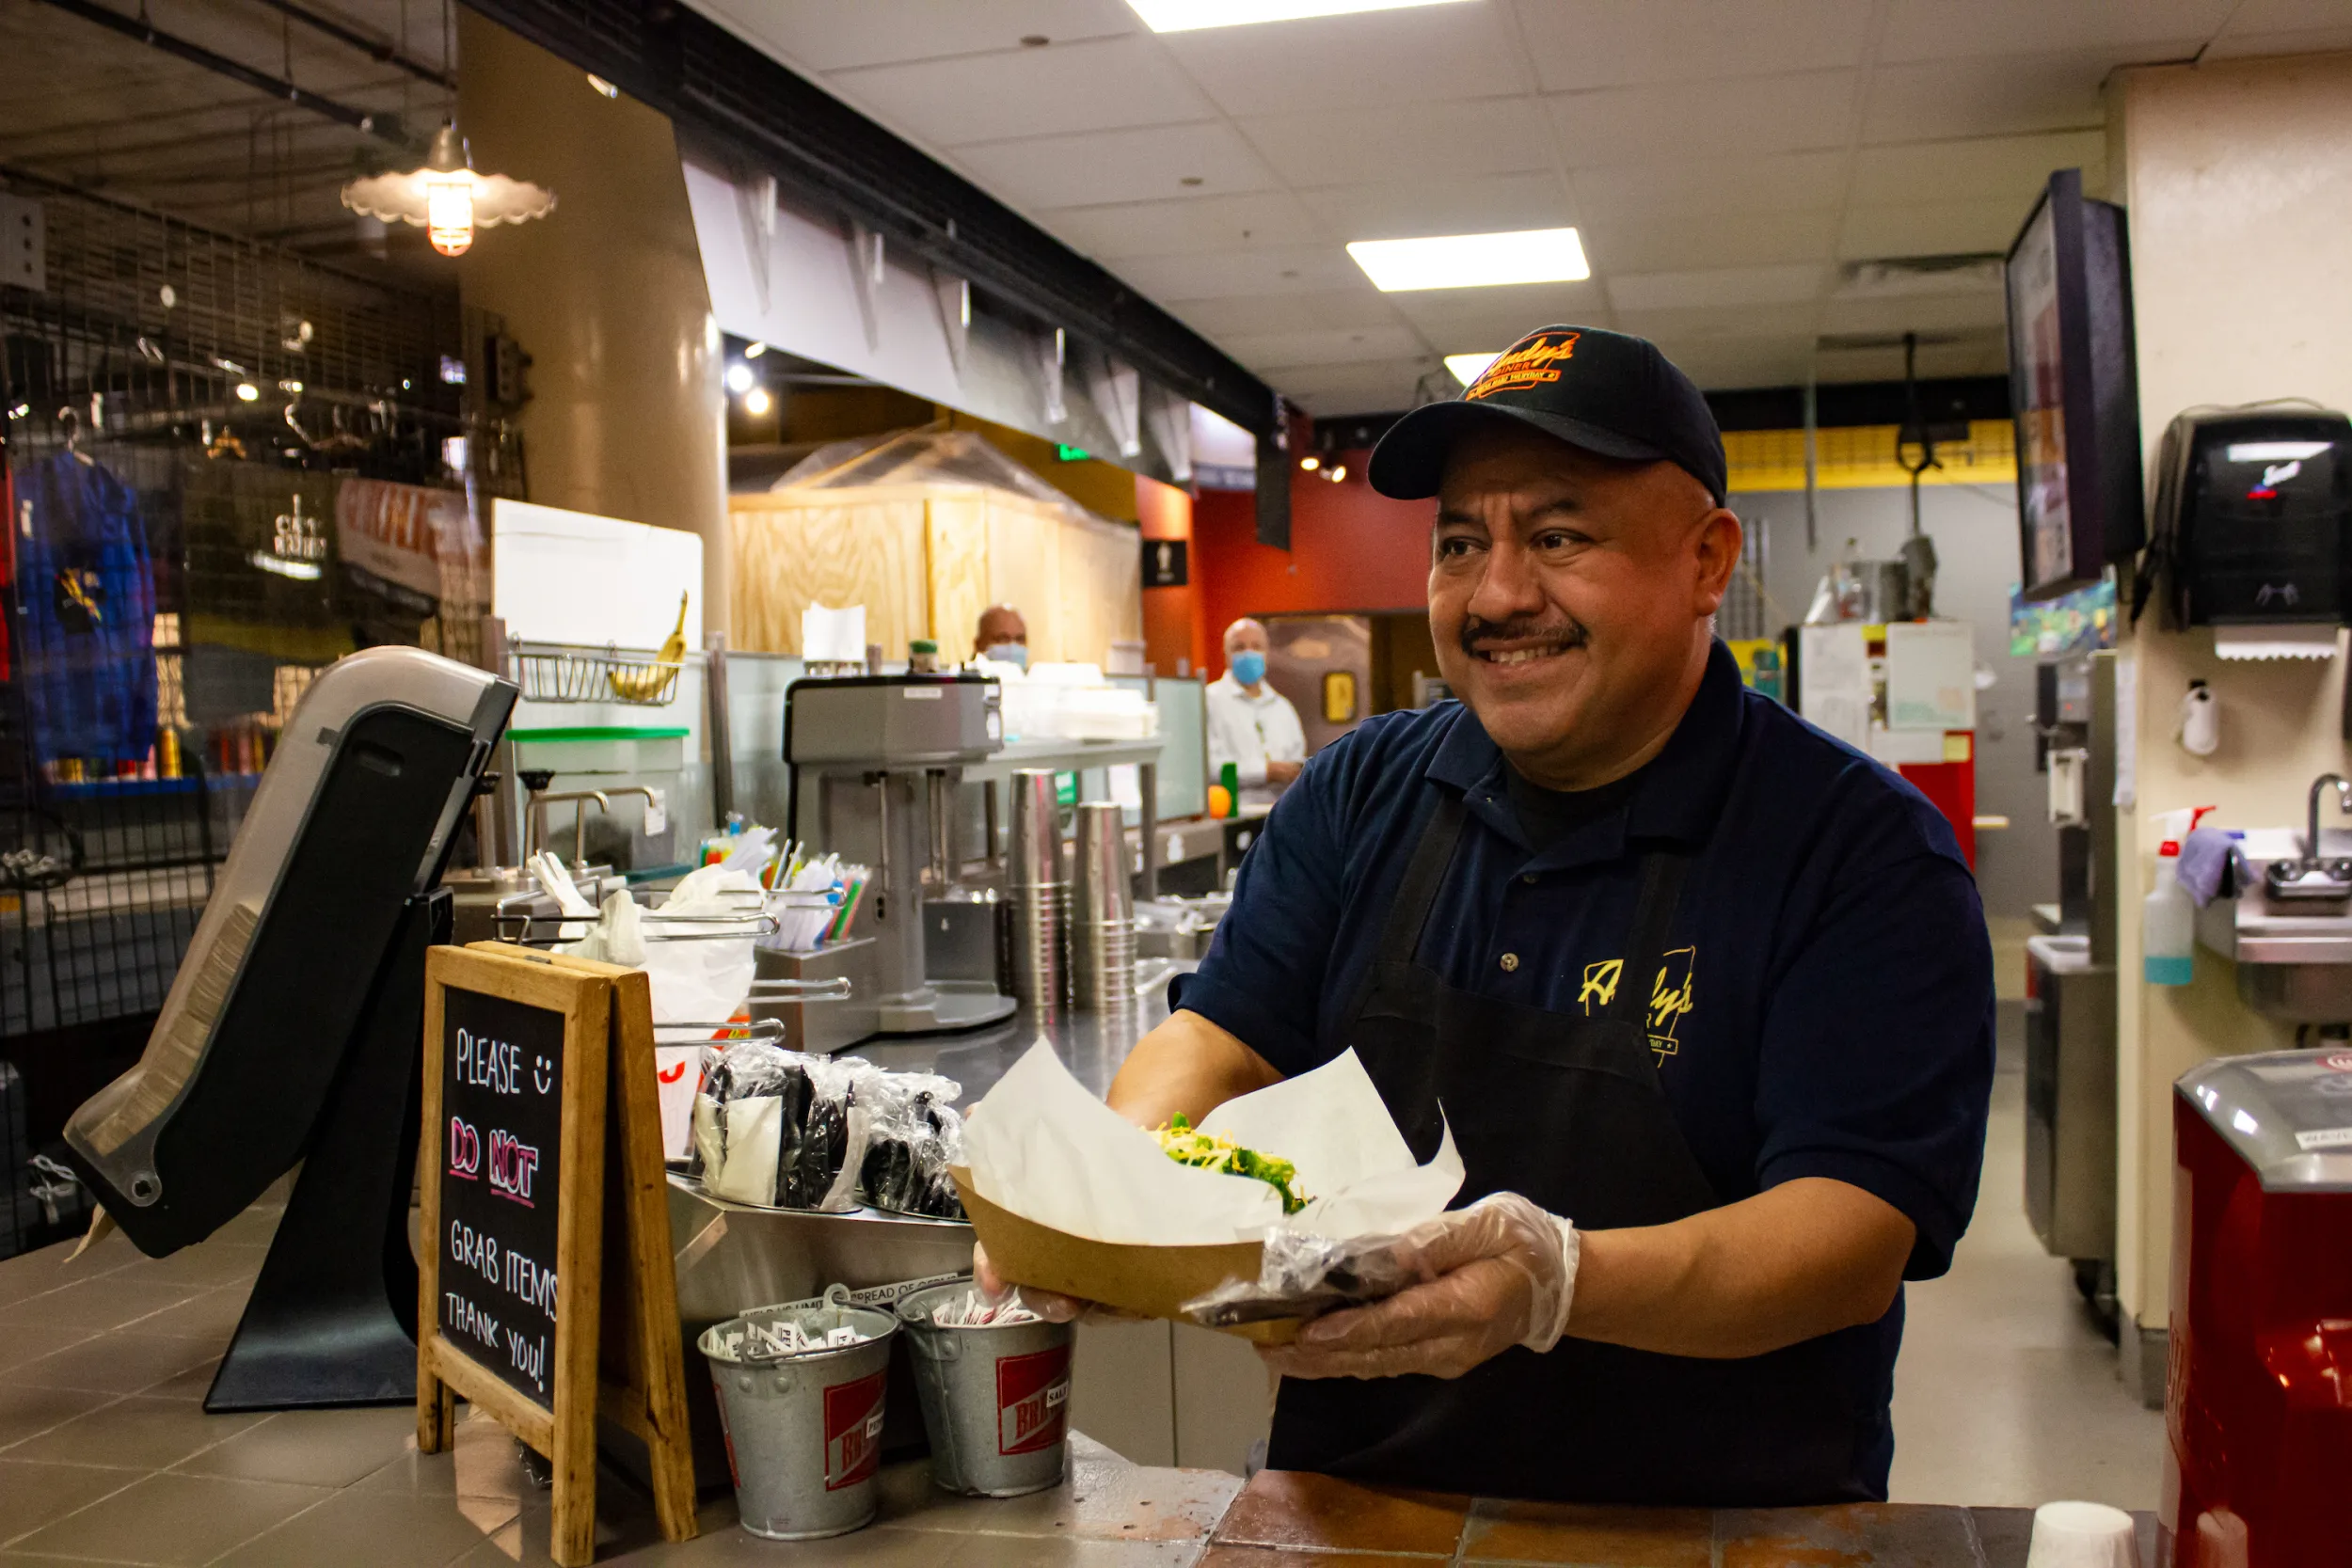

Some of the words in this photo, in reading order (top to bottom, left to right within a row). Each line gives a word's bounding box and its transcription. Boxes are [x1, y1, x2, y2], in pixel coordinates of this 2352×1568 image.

[457, 1027, 521, 1094] PLEASE
[451, 1116, 481, 1173] DO
[489, 1129, 539, 1198] NOT
[451, 1219, 500, 1285] GRAB
[505, 1249, 558, 1323] ITEMS
[445, 1291, 500, 1349] THANK
